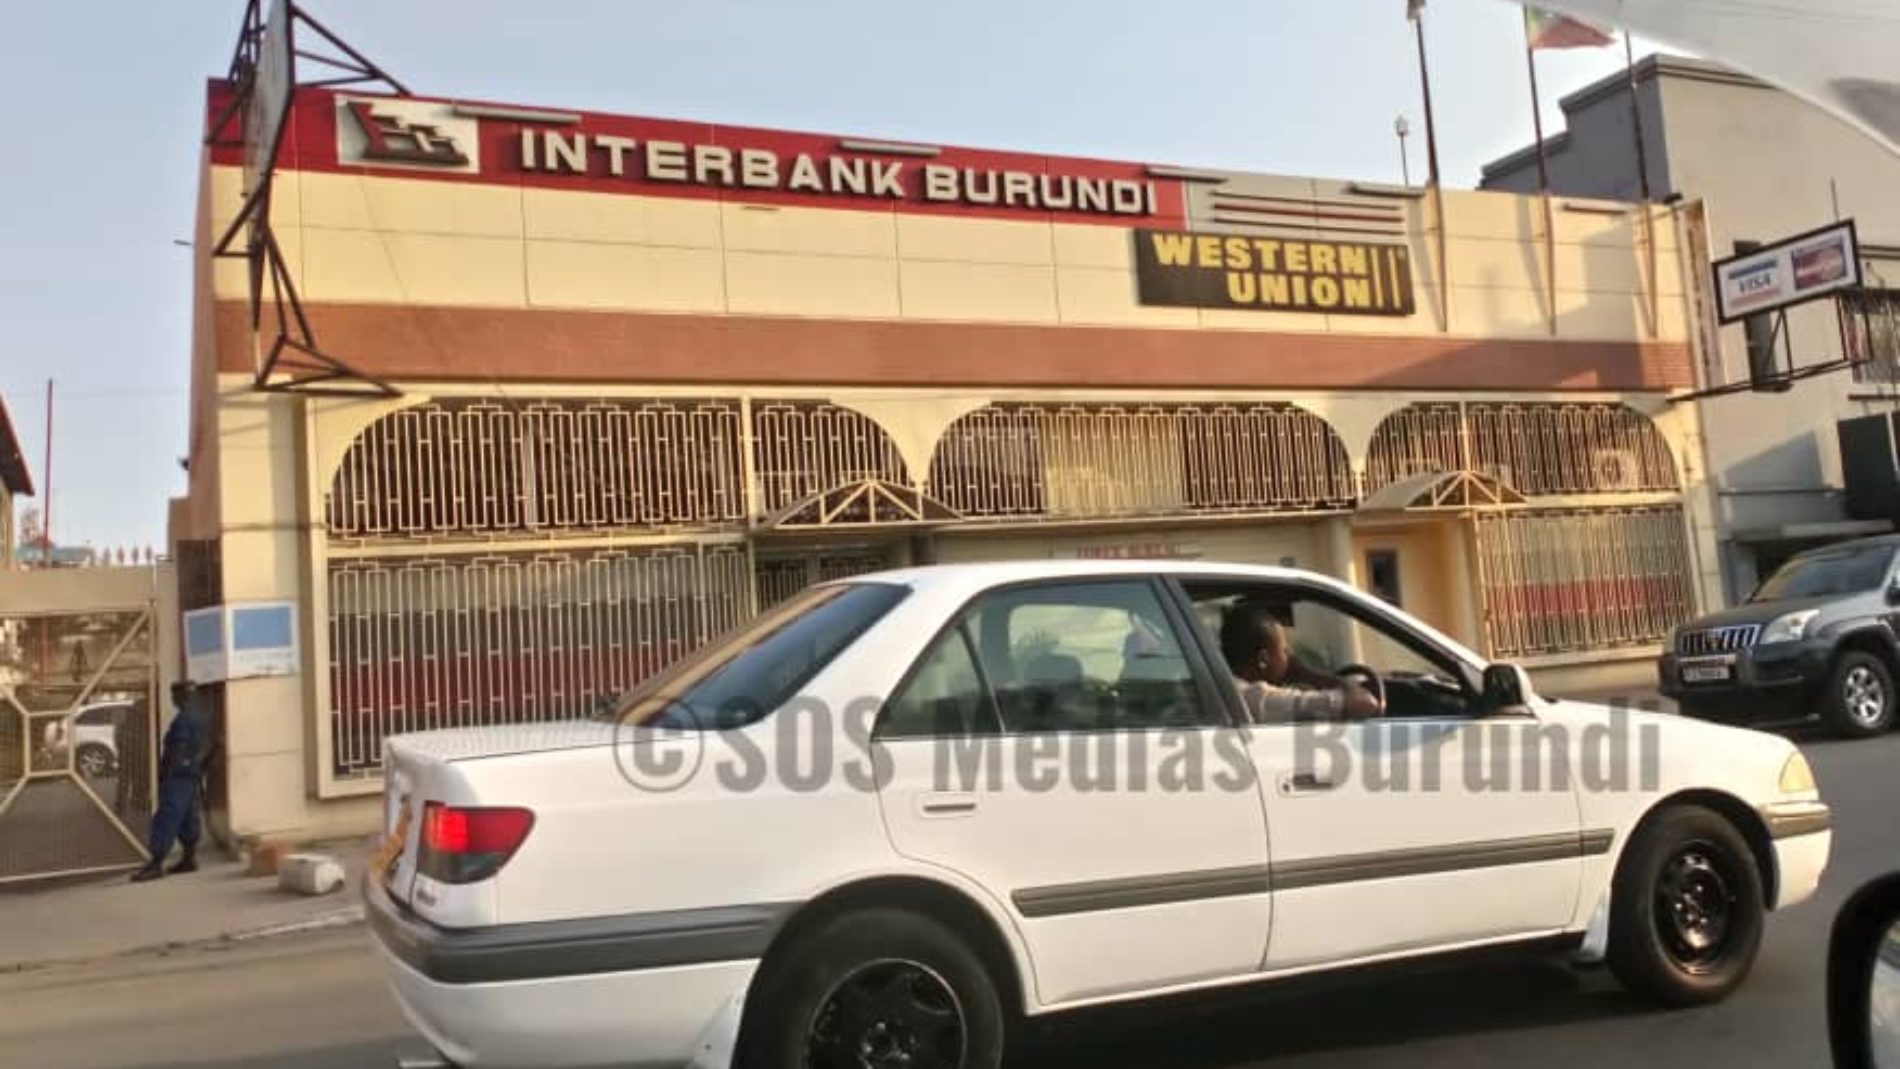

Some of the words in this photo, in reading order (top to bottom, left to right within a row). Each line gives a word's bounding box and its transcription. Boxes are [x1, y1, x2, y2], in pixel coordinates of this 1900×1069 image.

[521, 127, 904, 197] INTERBANK
[925, 164, 1158, 215] BURUNDI
[1151, 233, 1370, 275] WESTERN
[1226, 272, 1372, 307] UNION
